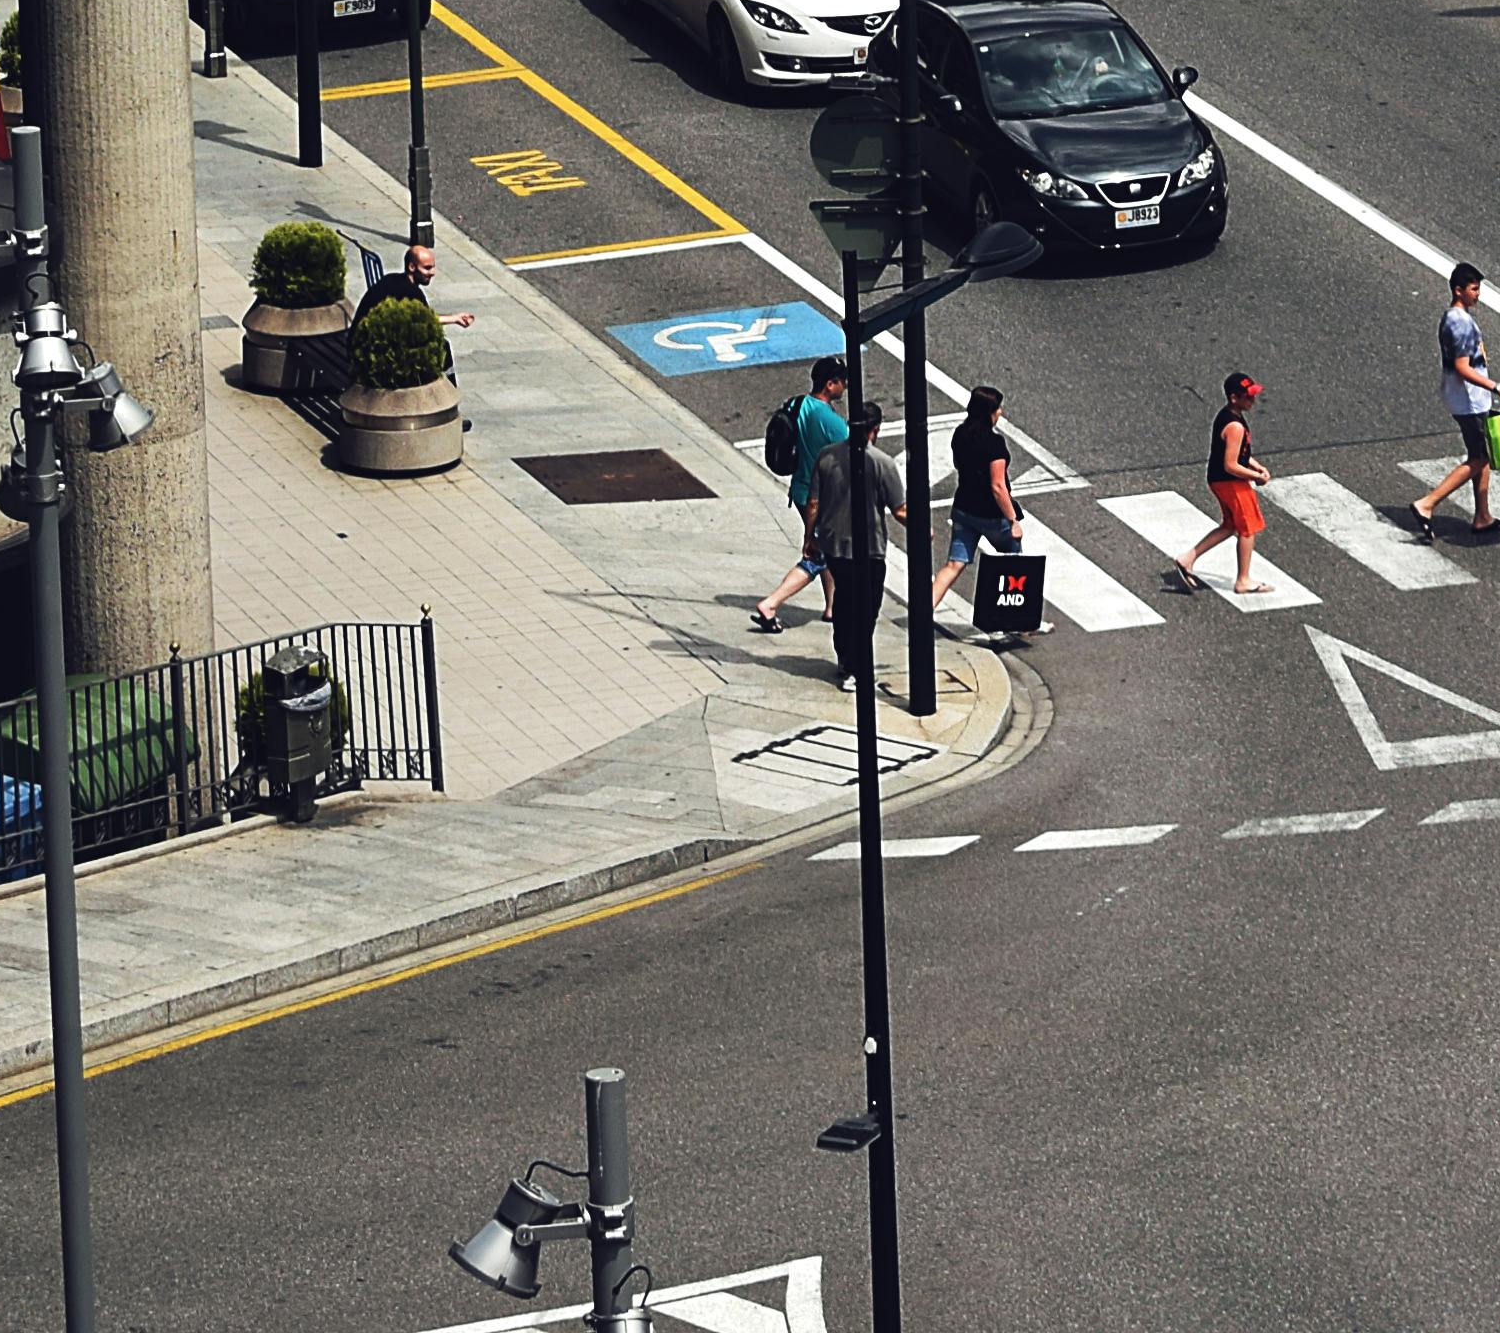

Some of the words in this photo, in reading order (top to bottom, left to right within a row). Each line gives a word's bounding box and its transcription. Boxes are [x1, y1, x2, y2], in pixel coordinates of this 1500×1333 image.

[469, 149, 587, 196] TAXI
[998, 574, 1005, 592] I
[996, 593, 1025, 607] AND
